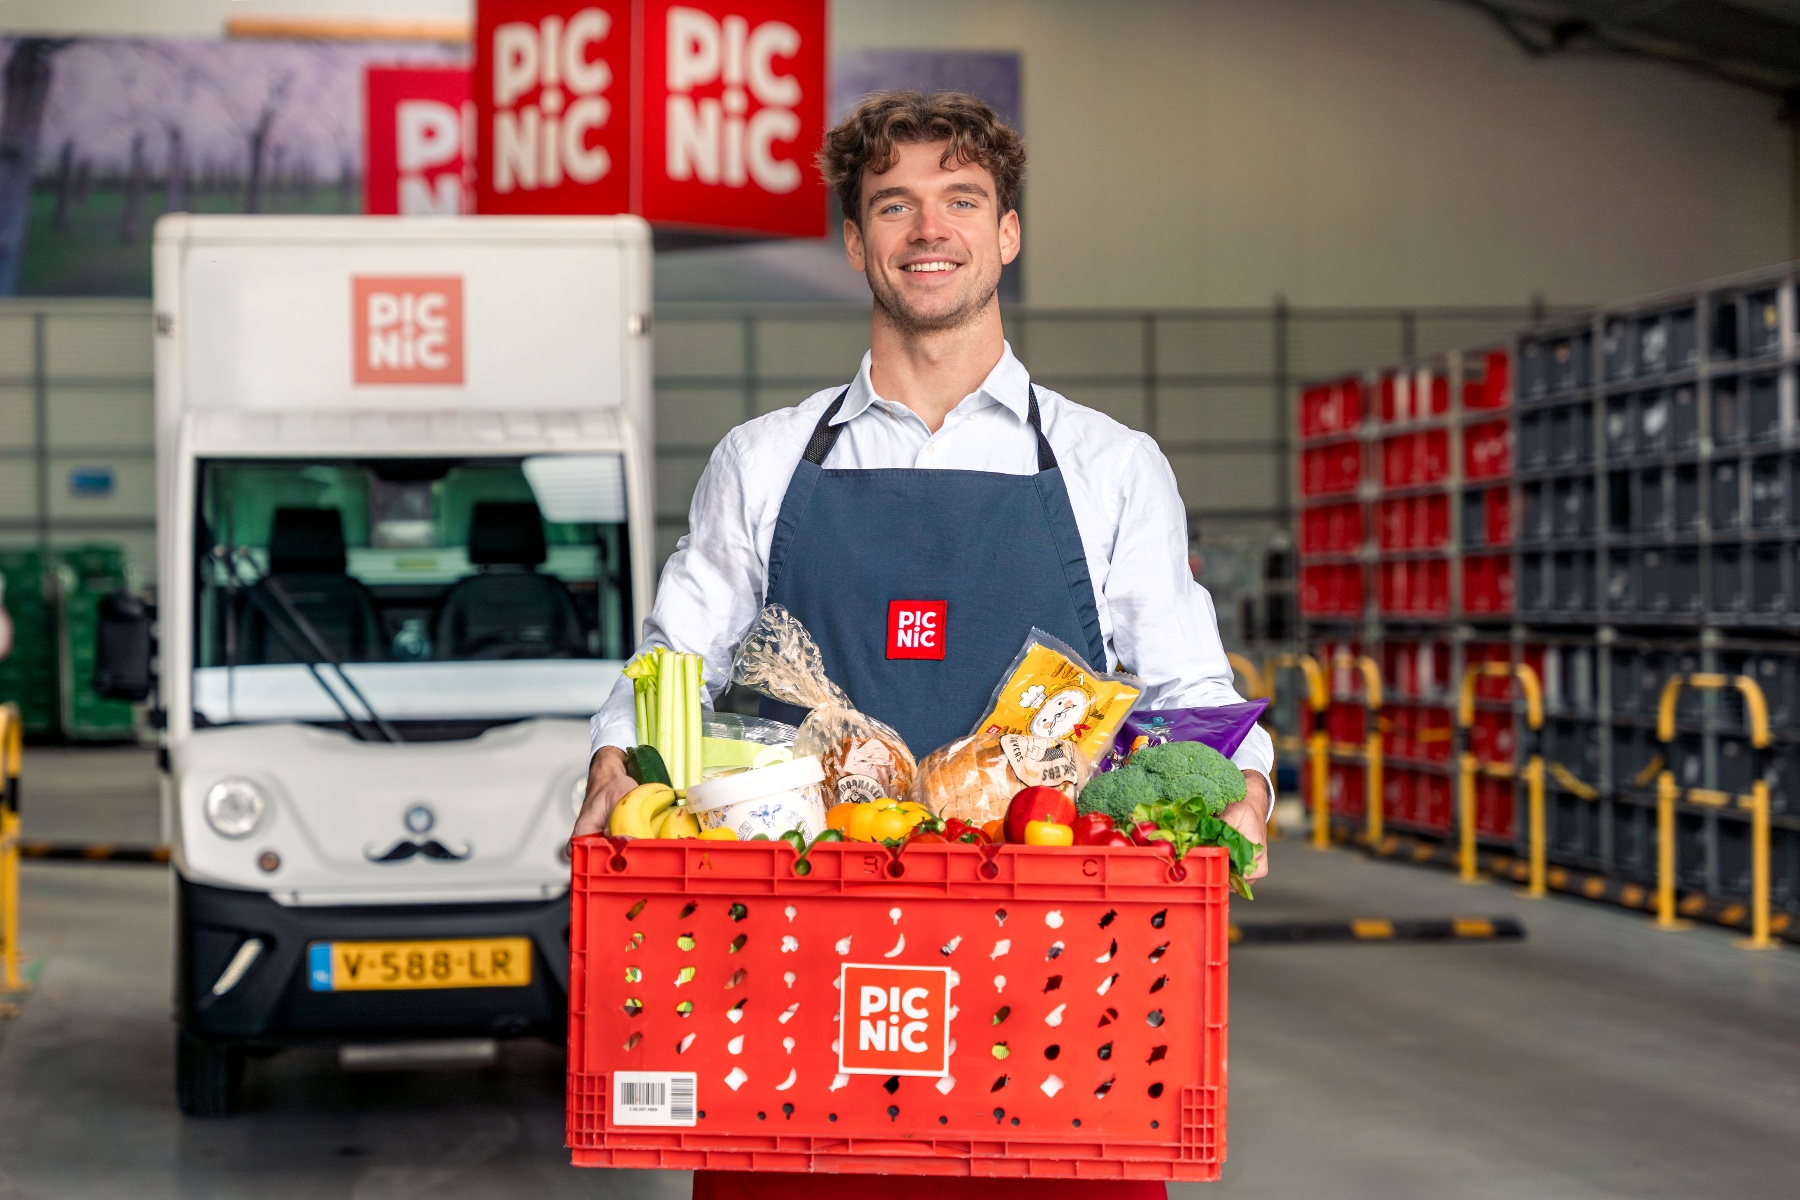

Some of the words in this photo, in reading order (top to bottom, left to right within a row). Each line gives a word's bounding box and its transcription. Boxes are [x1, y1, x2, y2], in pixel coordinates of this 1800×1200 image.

[493, 8, 612, 107] PIC
[666, 6, 802, 106] PIC
[368, 291, 449, 328] PIC
[898, 610, 937, 629] PIC
[1082, 858, 1098, 877] C
[342, 948, 513, 982] V-588-LR
[860, 985, 929, 1019] PIC
